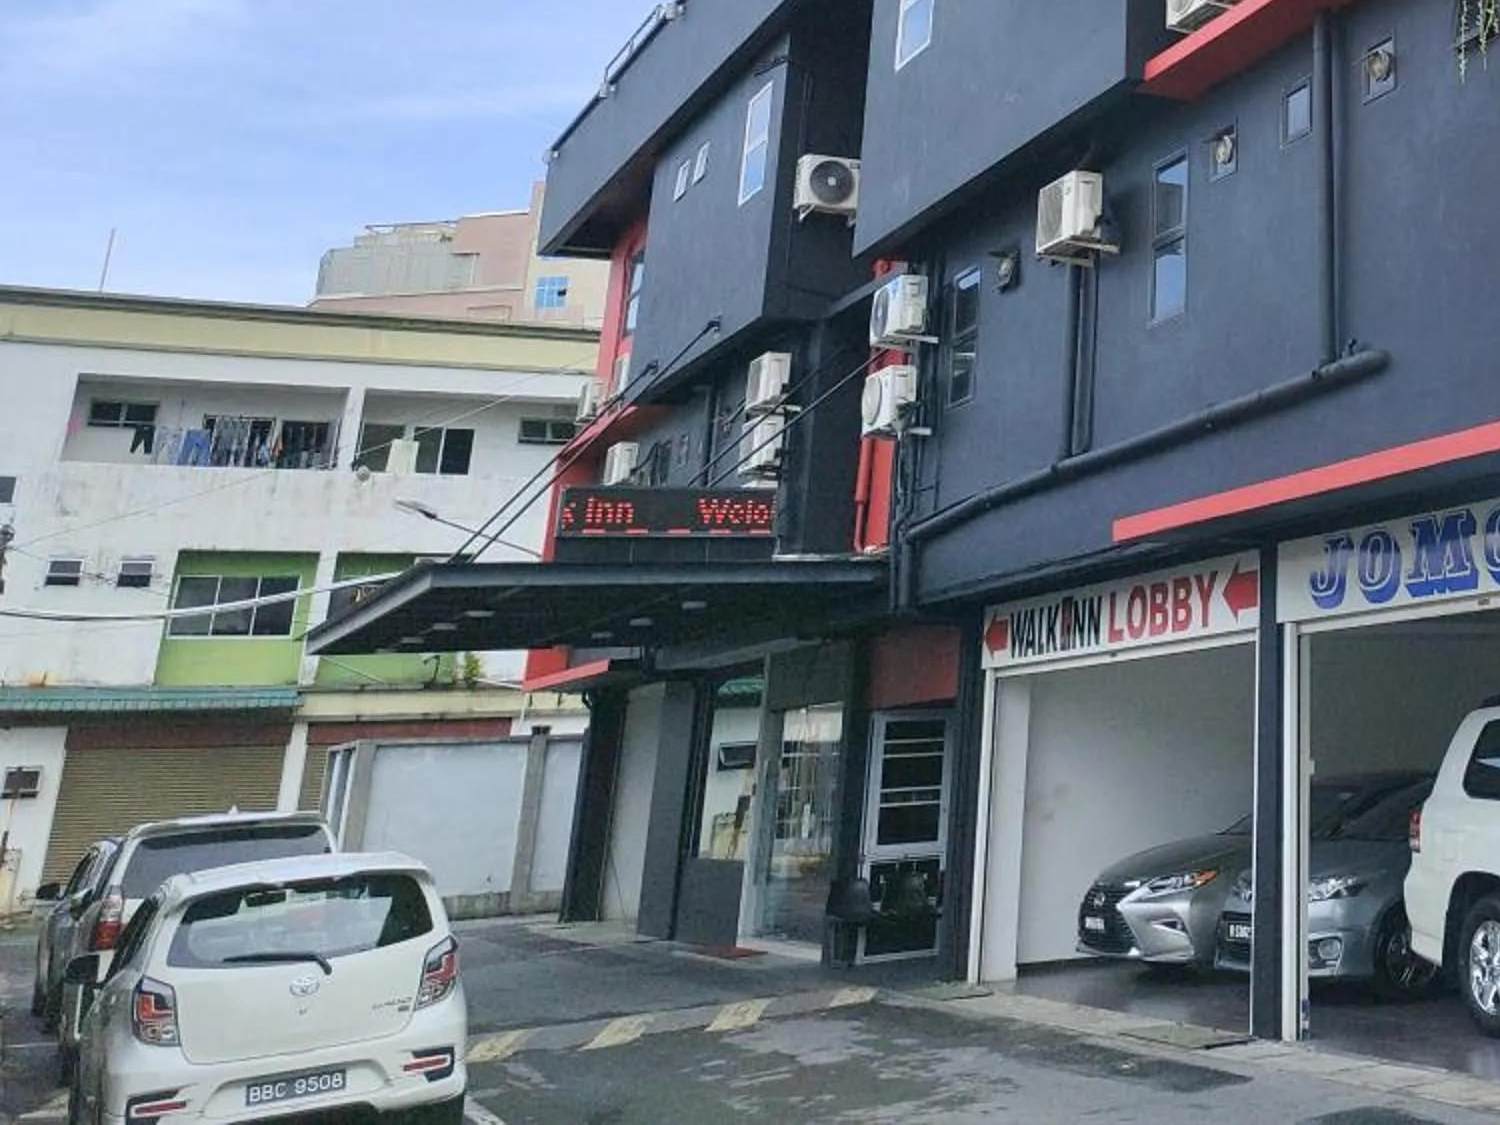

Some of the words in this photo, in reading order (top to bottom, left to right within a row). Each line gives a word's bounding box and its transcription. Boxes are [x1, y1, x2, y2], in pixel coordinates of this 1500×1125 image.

[1108, 570, 1219, 644] LOBBY
[250, 1082, 287, 1103] BBC
[295, 1073, 344, 1095] 9508
